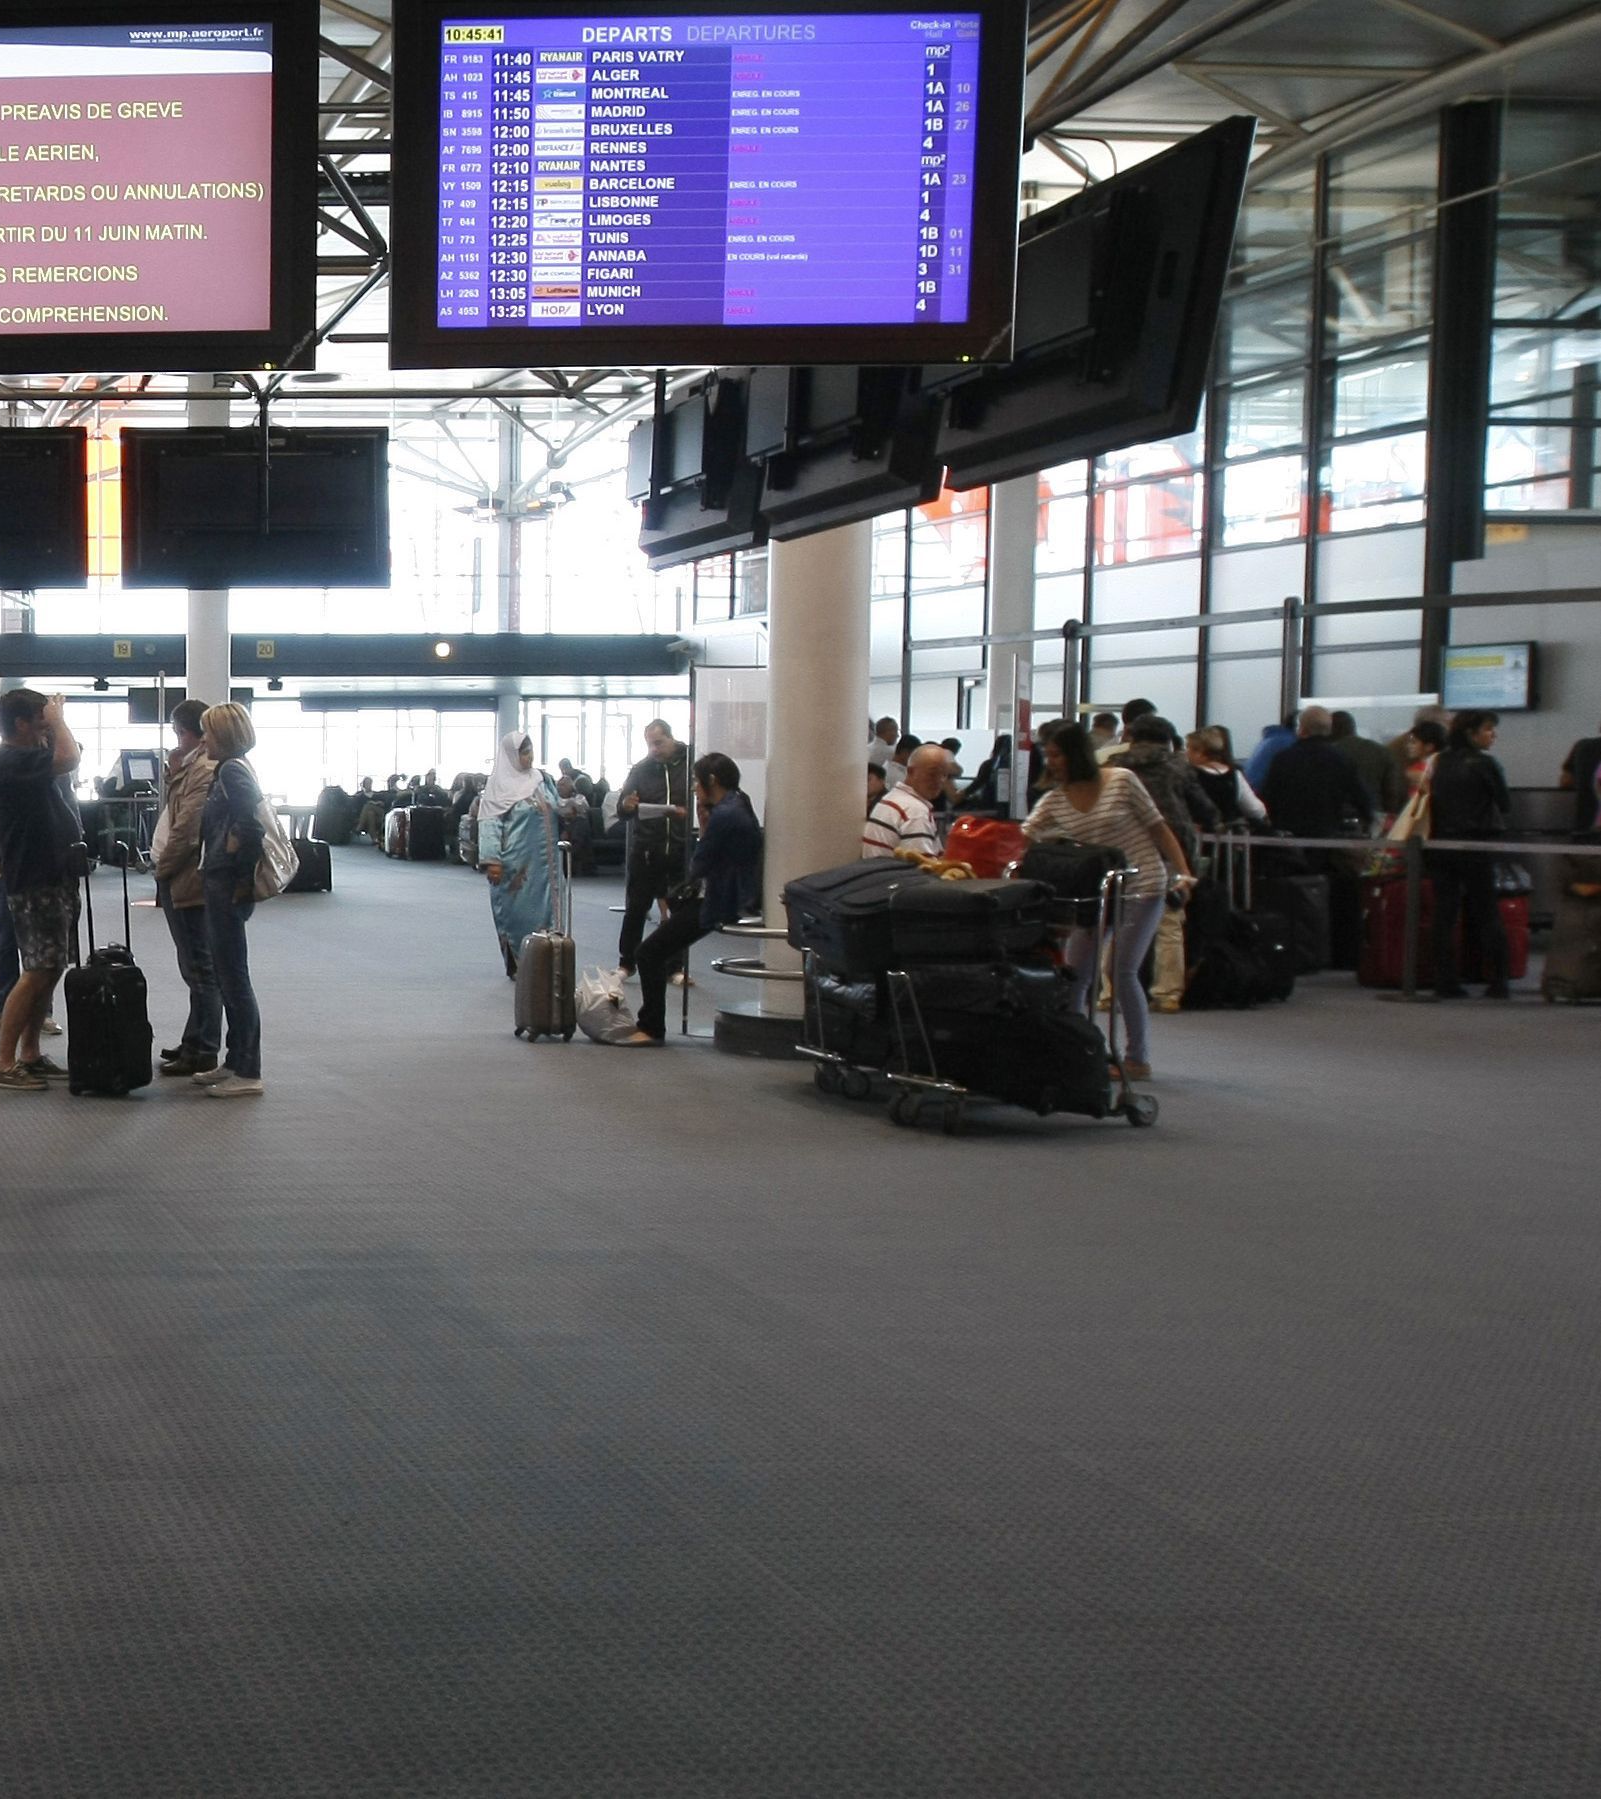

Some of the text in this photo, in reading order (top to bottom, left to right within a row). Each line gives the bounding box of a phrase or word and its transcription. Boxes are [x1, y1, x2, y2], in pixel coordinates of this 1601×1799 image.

[129, 27, 264, 40] www.mp.aeroport.fr
[445, 21, 950, 43] 10:45:41 DEPARTS DEPARTURES Check-in
[494, 51, 684, 65] 11:40 RYANAIR PARIS VATRY
[494, 71, 530, 83] 11:45
[592, 70, 639, 81] ALGER
[927, 64, 934, 75] 1
[494, 82, 944, 101] 11:45 MONTREAL 1A
[1, 104, 80, 120] PREAVIS
[88, 103, 112, 118] DE
[118, 102, 182, 118] GREVE
[494, 100, 944, 120] 11:50 MADRID 1A
[493, 119, 942, 138] 12:00 BRUXELLES 1B
[25, 145, 98, 162] AERIEN,
[493, 137, 932, 156] 12:00 RENNES 4
[492, 160, 645, 174] 12:10 RYANAIR NANTES
[492, 173, 940, 192] 12:15 BARCELONE 1A
[91, 185, 117, 200] OU
[124, 183, 263, 201] ANNULATIONS)
[492, 198, 527, 210] 12:15
[590, 196, 658, 207] LISBONNE
[922, 191, 928, 203] 1
[492, 209, 929, 228] 12:20 LIMOGES 4
[42, 227, 66, 241] DU
[75, 226, 90, 241] 11
[99, 225, 139, 240] JUIN
[146, 225, 207, 240] MATIN.
[491, 234, 527, 246] 12:25
[589, 233, 628, 243] TUNIS
[921, 227, 938, 239] 1B
[491, 245, 937, 264] 12:30 ANNABA 1D
[13, 266, 137, 282] REMERCIONS
[490, 263, 927, 282] 12:30 FIGARI 3
[490, 281, 935, 299] 13:05 MUNICH 1B
[0, 306, 168, 323] COMPREHENSION.
[490, 299, 925, 317] 13:25 LYON 4
[117, 643, 129, 655] 19
[258, 643, 273, 655] 20
